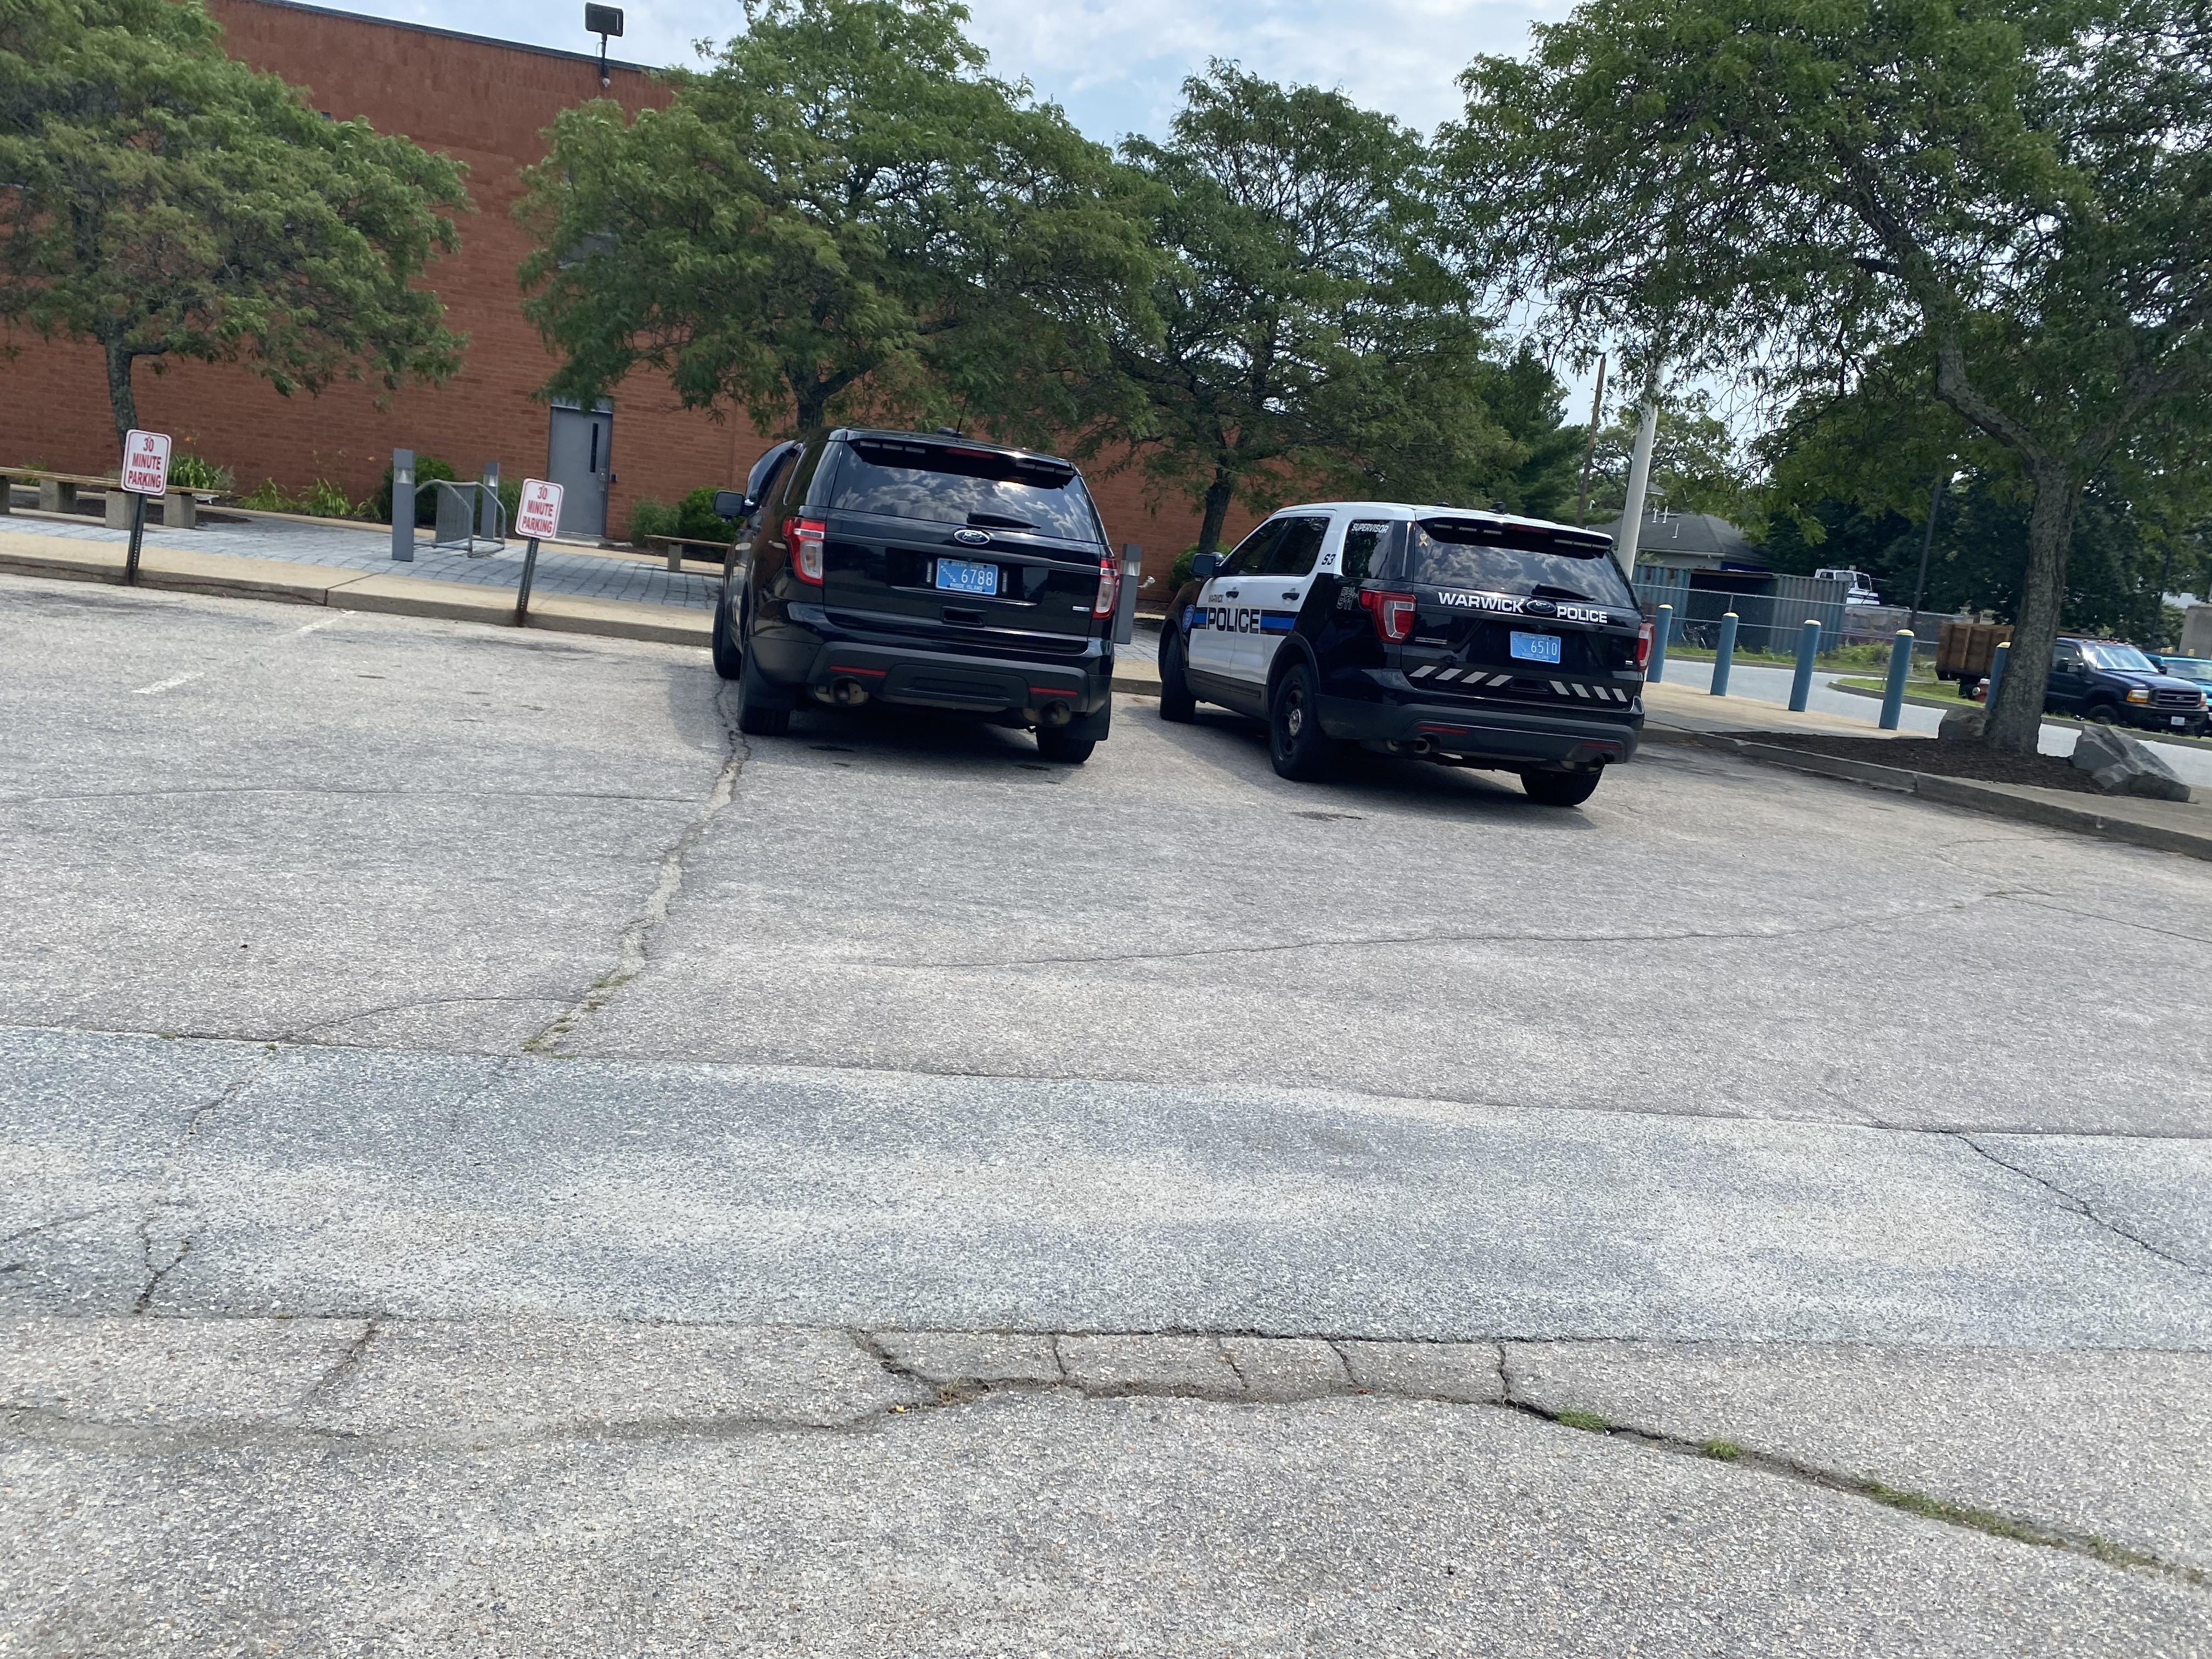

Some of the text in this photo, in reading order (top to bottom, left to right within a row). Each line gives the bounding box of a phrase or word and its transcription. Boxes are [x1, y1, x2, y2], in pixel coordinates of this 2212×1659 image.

[143, 437, 154, 452] 30
[132, 453, 161, 470] MINUTE
[128, 470, 161, 488] PARKING
[537, 487, 548, 500] 30
[527, 500, 554, 517] MINUTE
[522, 516, 552, 533] PARKING
[1351, 523, 1389, 534] SUPERVISOR
[1321, 554, 1336, 566] S3
[940, 565, 957, 582] POLICE
[961, 568, 994, 586] 6788
[1437, 591, 1524, 613] WARWICK
[1556, 606, 1607, 624] POLICE
[1207, 607, 1261, 634] POLICE
[1531, 640, 1558, 656] 6510
